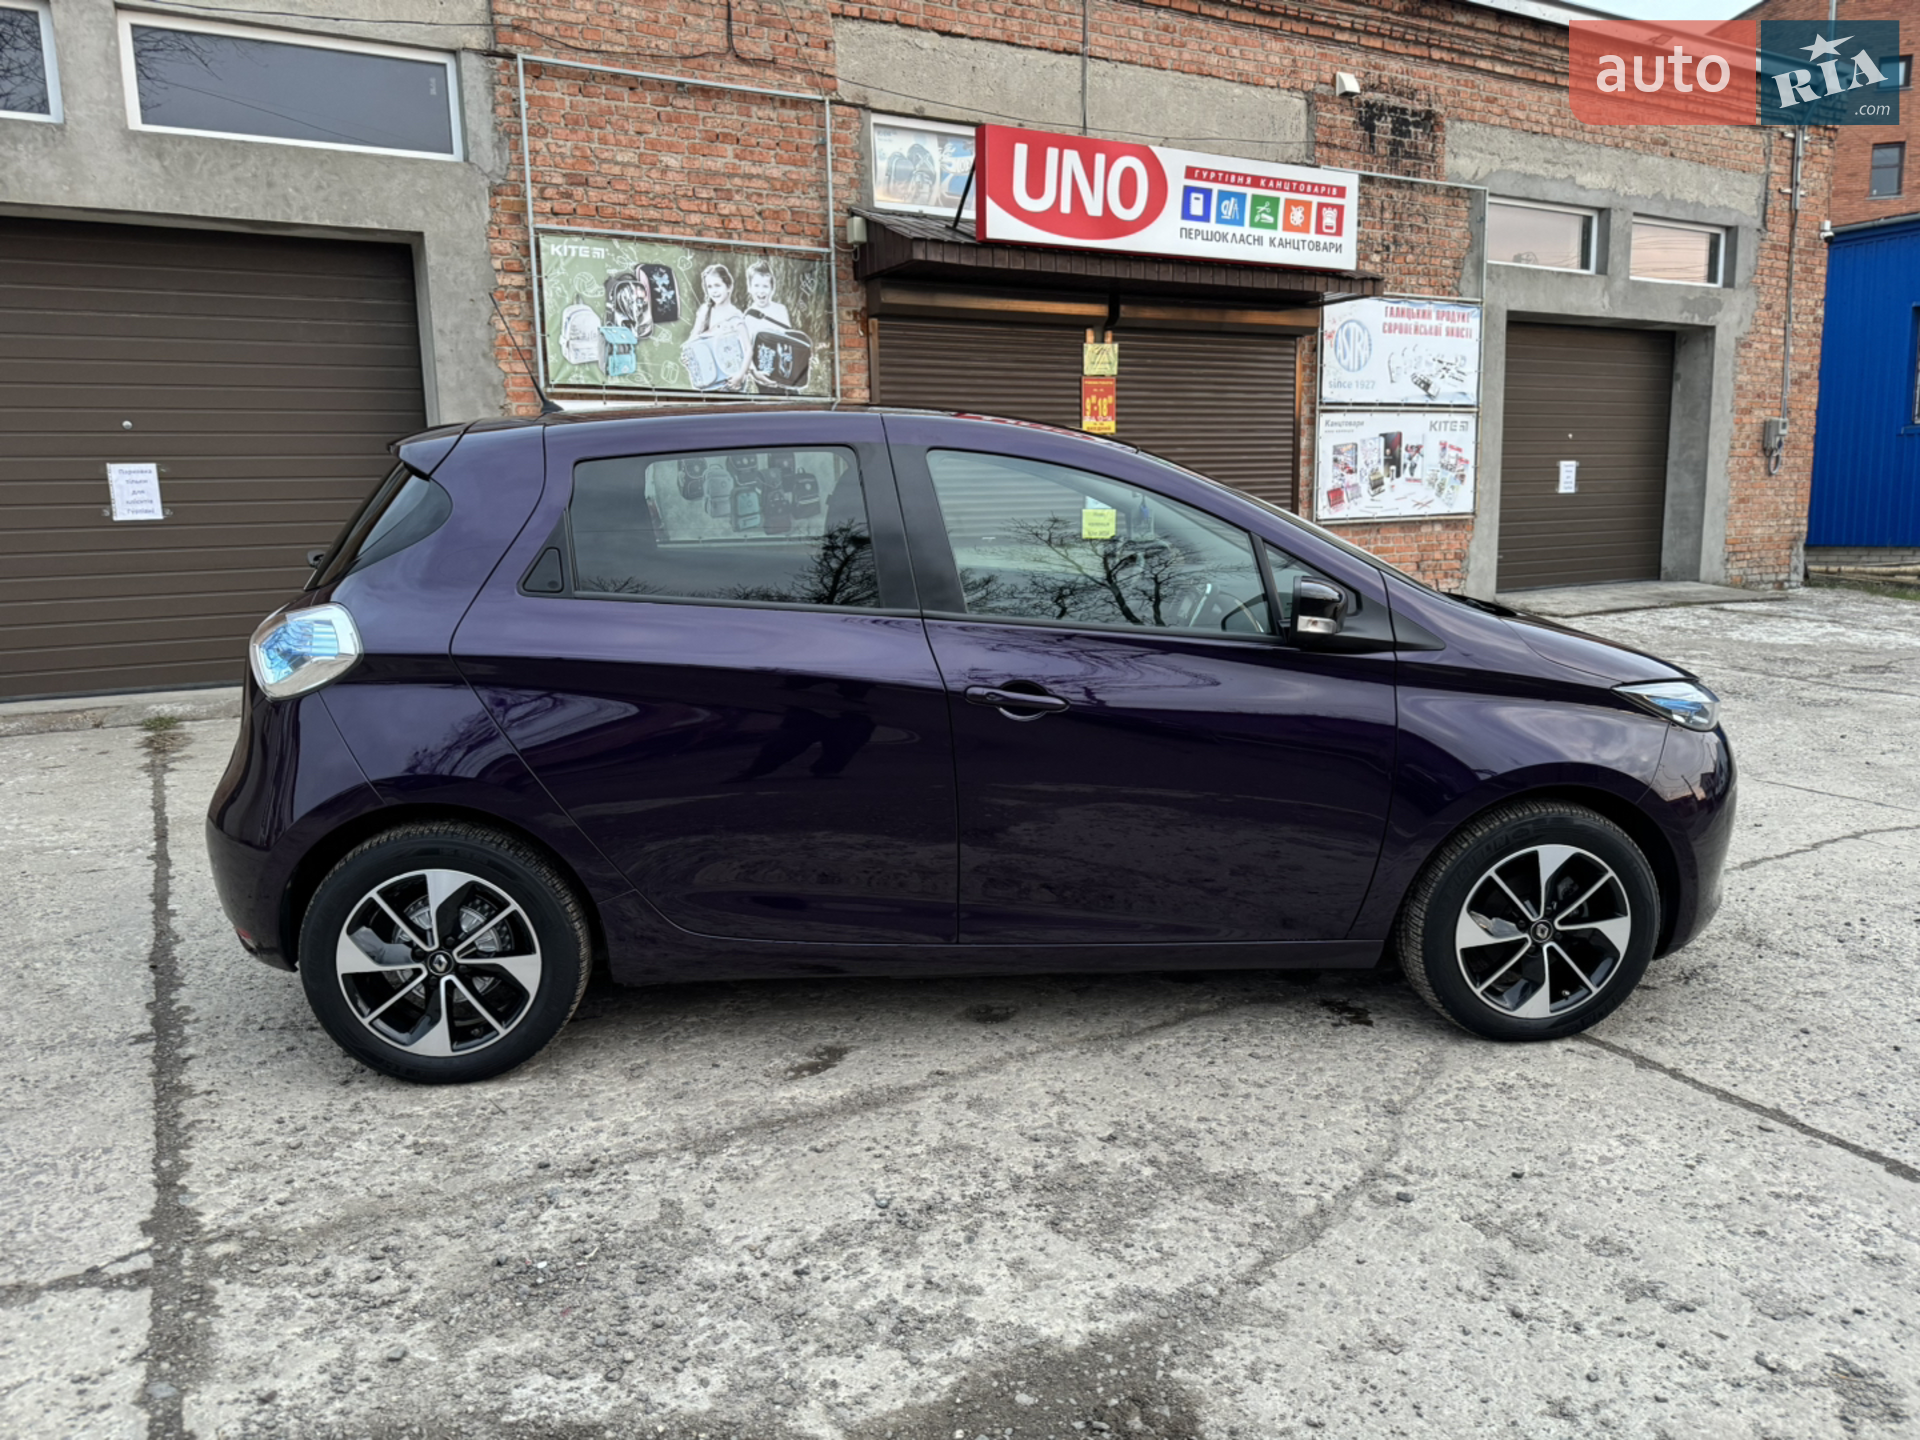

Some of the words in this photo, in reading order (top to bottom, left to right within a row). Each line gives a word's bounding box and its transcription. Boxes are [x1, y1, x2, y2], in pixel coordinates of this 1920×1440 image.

[1012, 142, 1149, 222] UNO
[1260, 178, 1339, 196] КАНЦТОВАРІВ
[1179, 227, 1264, 247] ПЕРШОКЛАСНІ
[1268, 238, 1343, 255] КАНЦТОВАРИ
[551, 243, 591, 258] KITE
[1385, 306, 1433, 321] ГАЛИЦЬКИЙ
[1436, 309, 1470, 323] ПРОДУКТ
[1382, 322, 1442, 337] ЄВРОПЕЙСЬКОЇ
[1445, 326, 1473, 339] ЯКОСТІ
[1328, 379, 1353, 390] since
[1354, 380, 1376, 390] 1927
[1325, 419, 1365, 428] Канцтовари
[1429, 420, 1458, 432] KITE
